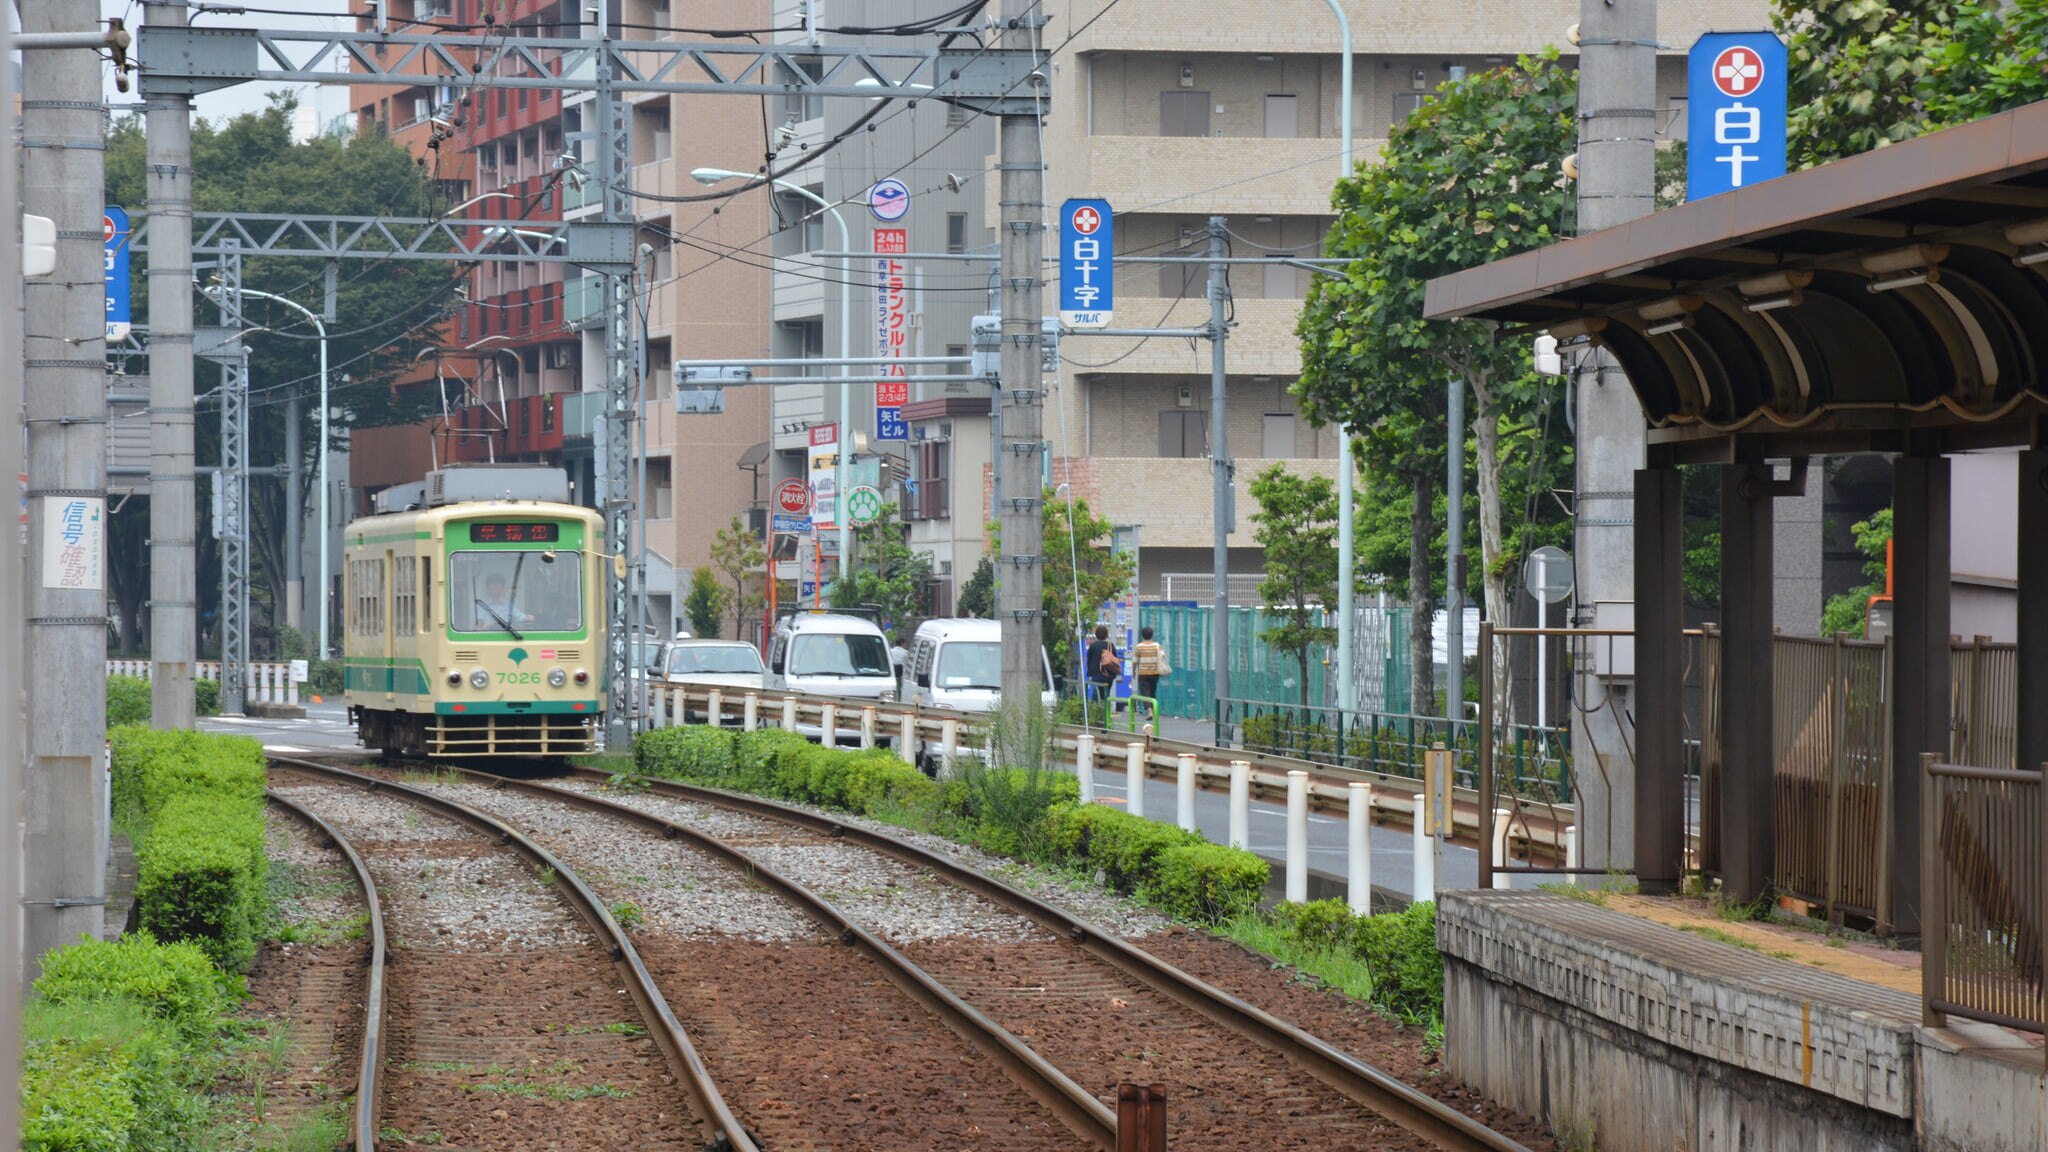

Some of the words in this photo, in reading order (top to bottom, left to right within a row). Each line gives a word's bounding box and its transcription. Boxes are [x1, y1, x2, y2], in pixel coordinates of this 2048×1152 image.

[1714, 101, 1761, 188] 白十
[877, 232, 905, 243] 24h
[1073, 236, 1100, 308] 白十字
[1073, 312, 1101, 324] サルバ
[882, 424, 904, 437] ビル
[496, 672, 542, 685] 7026
